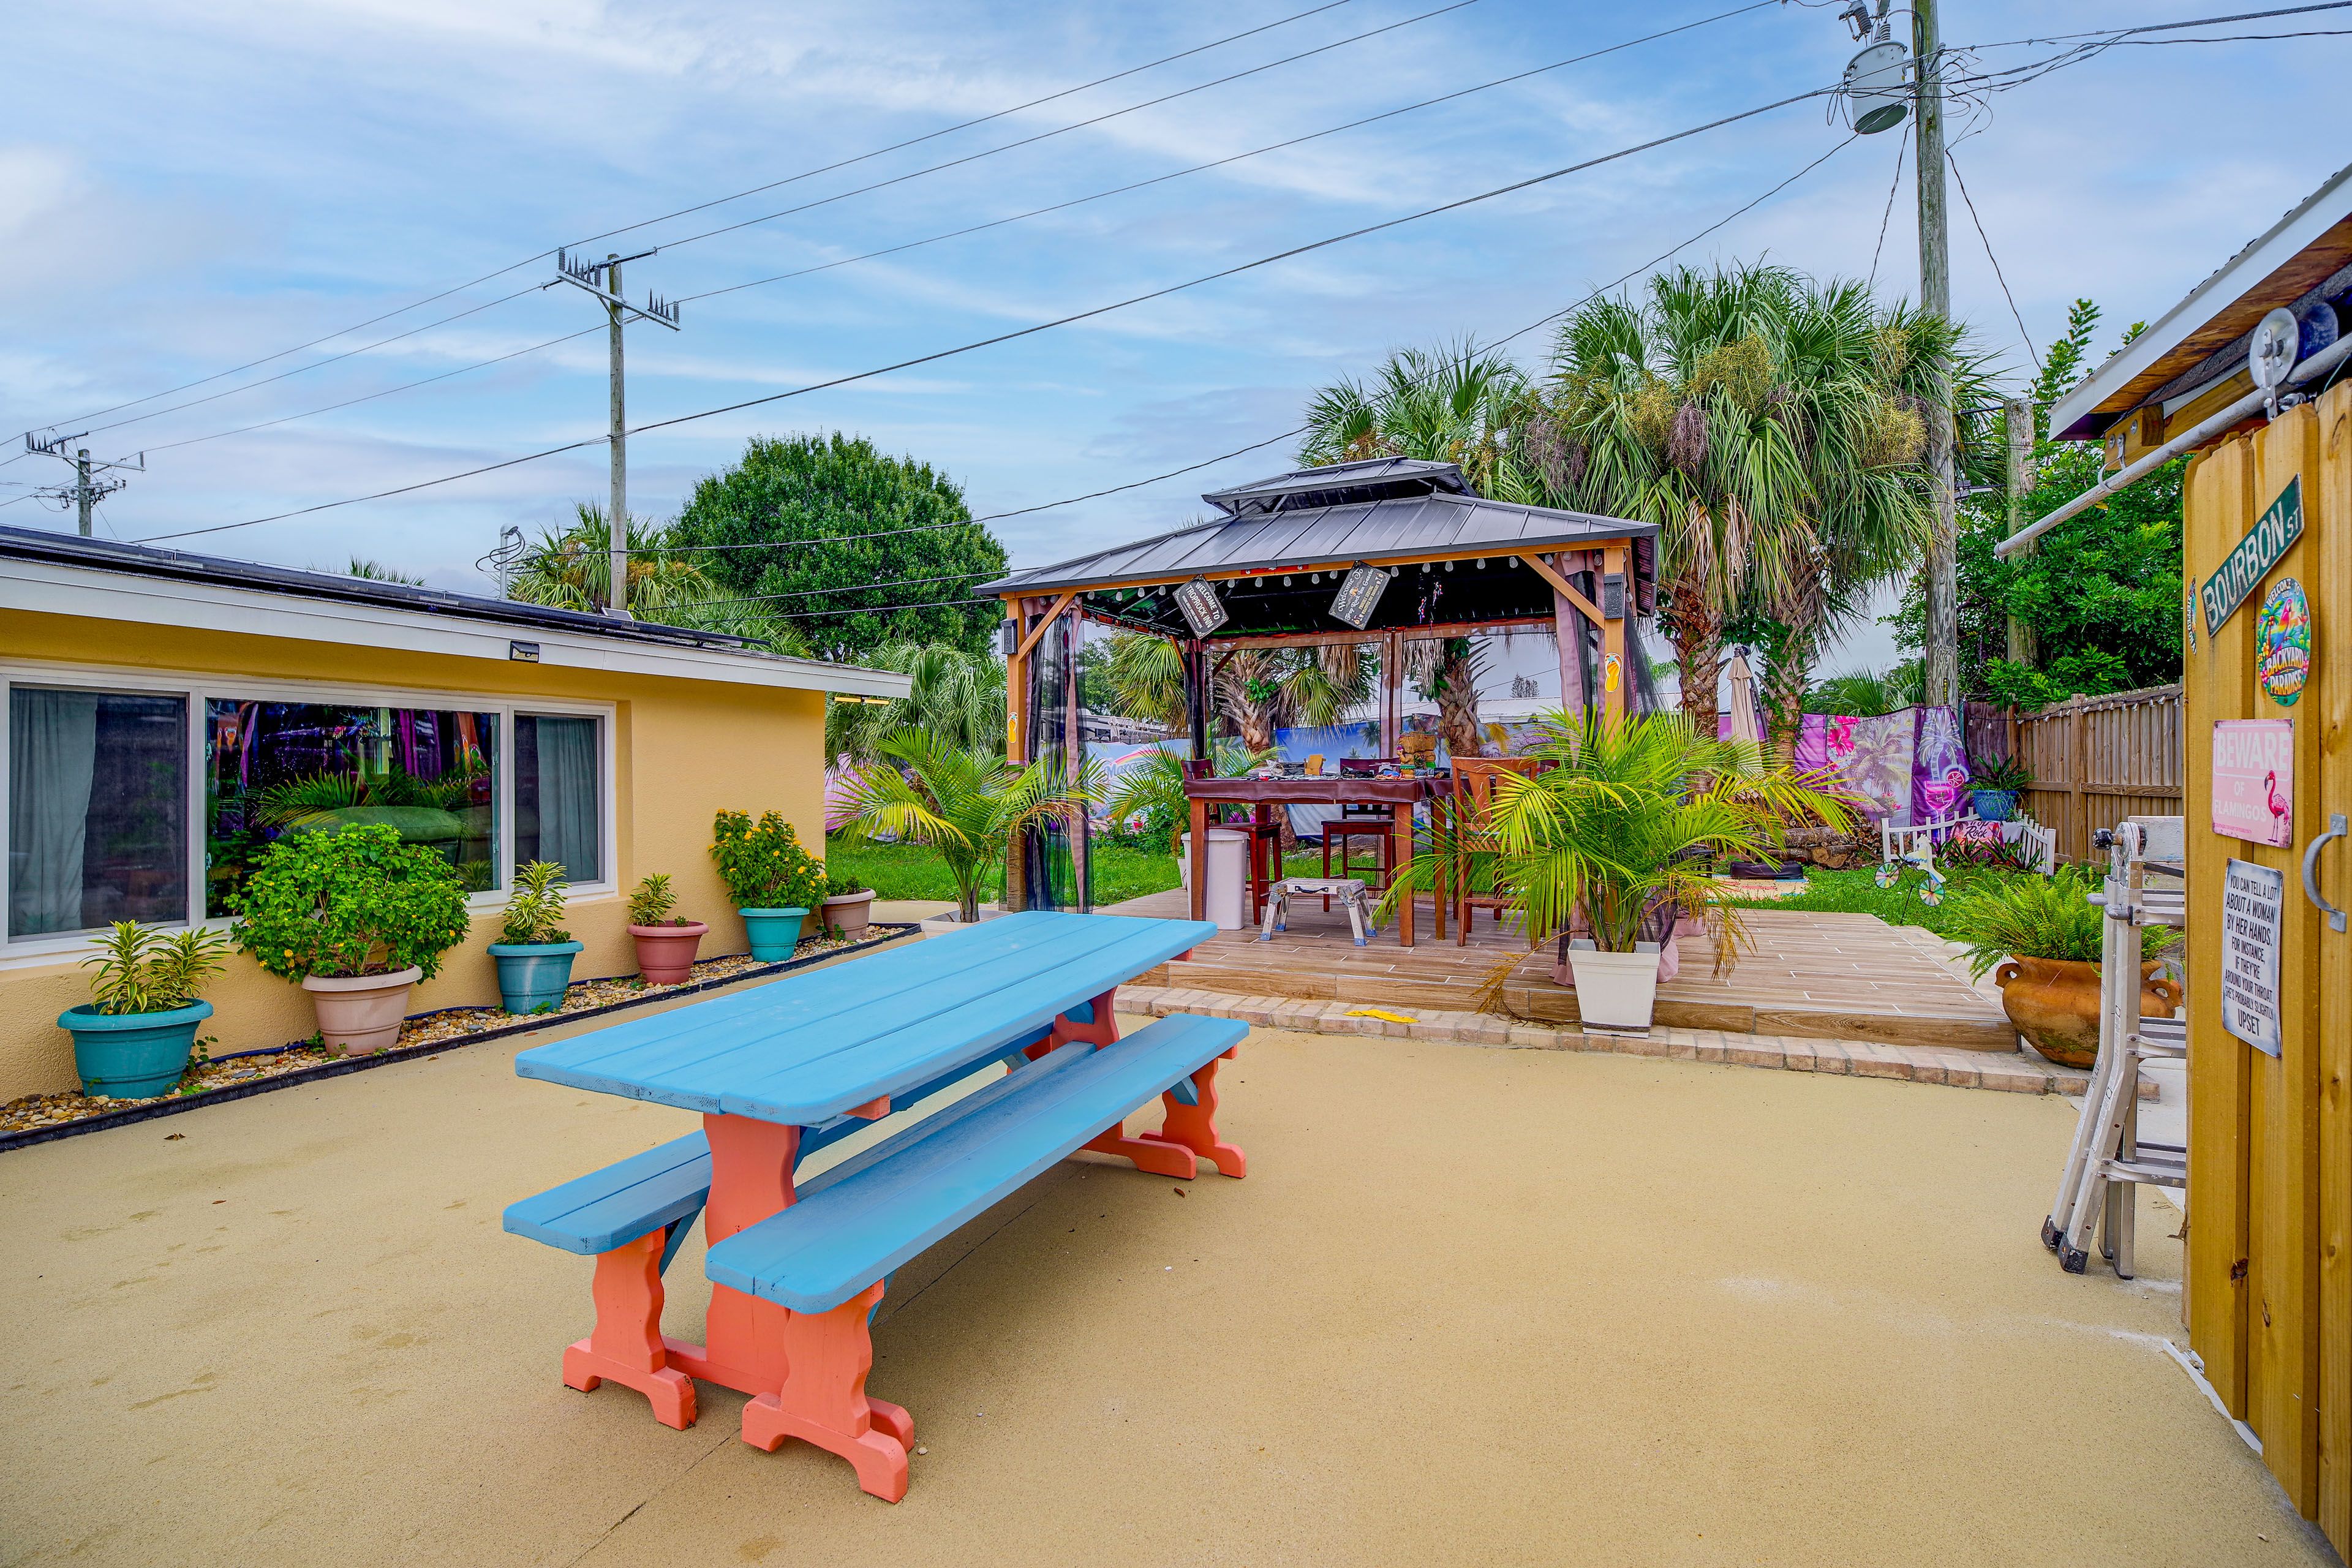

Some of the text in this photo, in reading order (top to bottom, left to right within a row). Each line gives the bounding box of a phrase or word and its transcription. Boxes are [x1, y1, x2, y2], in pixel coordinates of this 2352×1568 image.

[2204, 501, 2299, 629] BOURBON ST
[1195, 581, 1219, 620] WELCOME TO
[1338, 568, 1363, 611] Welcome To
[1345, 608, 1354, 620] Trop
[1351, 596, 1360, 607] Rock
[1362, 569, 1373, 586] Gazebo
[2266, 578, 2300, 607] WELCOME TO
[1186, 585, 1214, 628] TROPROCK INN
[2266, 647, 2304, 678] BACKYARD
[2270, 669, 2302, 695] PARADISE
[2217, 732, 2290, 771] BEWARE
[2235, 781, 2245, 796] OF
[2214, 799, 2266, 823] FLAMINGOS
[1964, 826, 1988, 839] Rock
[2231, 875, 2277, 901] YOU CAN TELL A LOT
[2226, 892, 2275, 924] ABOUT A WOMAN
[2227, 913, 2272, 946] BY HER HANDS.
[2236, 956, 2260, 979] IF THEY'RE
[2241, 941, 2265, 965] INSTANCE,
[2225, 969, 2274, 1005] AROUND YOUR THROAT.
[2225, 986, 2273, 1020] SHE'S PROBABLY SLIGHTLY
[2238, 1009, 2260, 1036] UPSET
